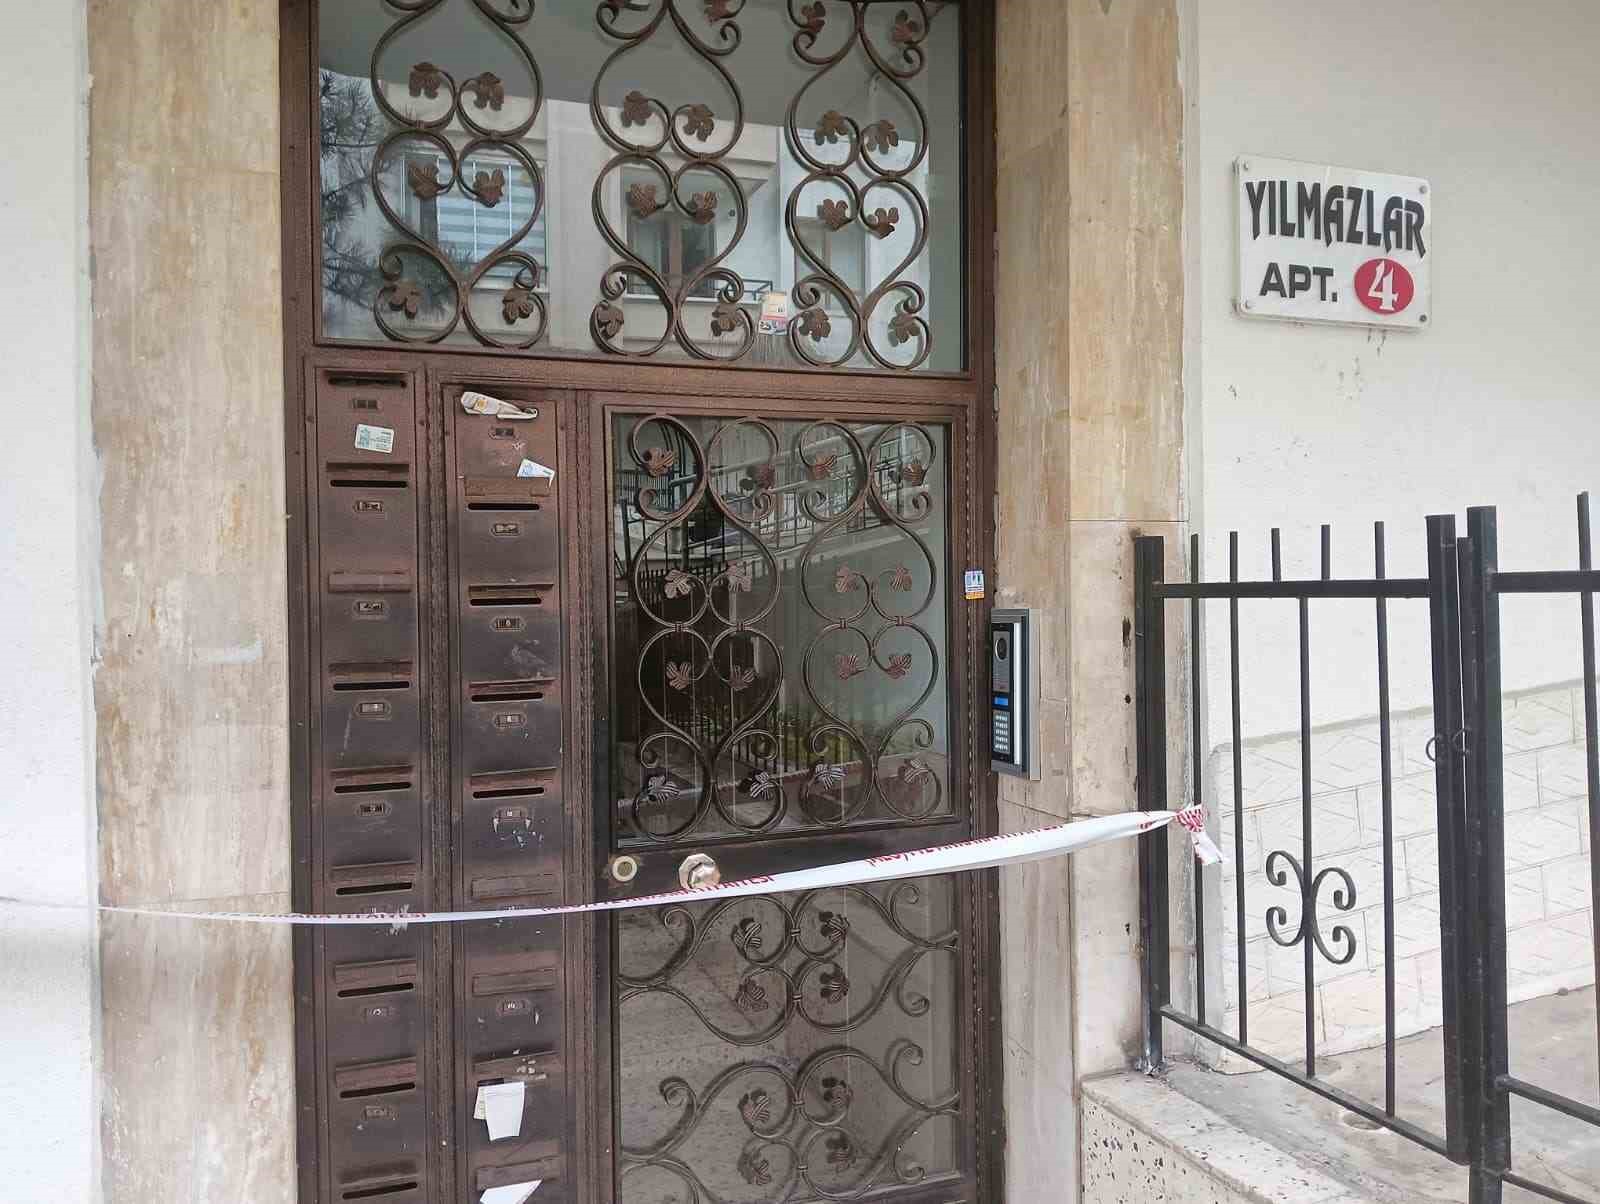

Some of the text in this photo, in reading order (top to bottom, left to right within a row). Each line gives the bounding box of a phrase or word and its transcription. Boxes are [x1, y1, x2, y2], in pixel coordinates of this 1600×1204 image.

[1245, 180, 1426, 259] YILMAZLAR
[1259, 260, 1400, 311] APT. 4
